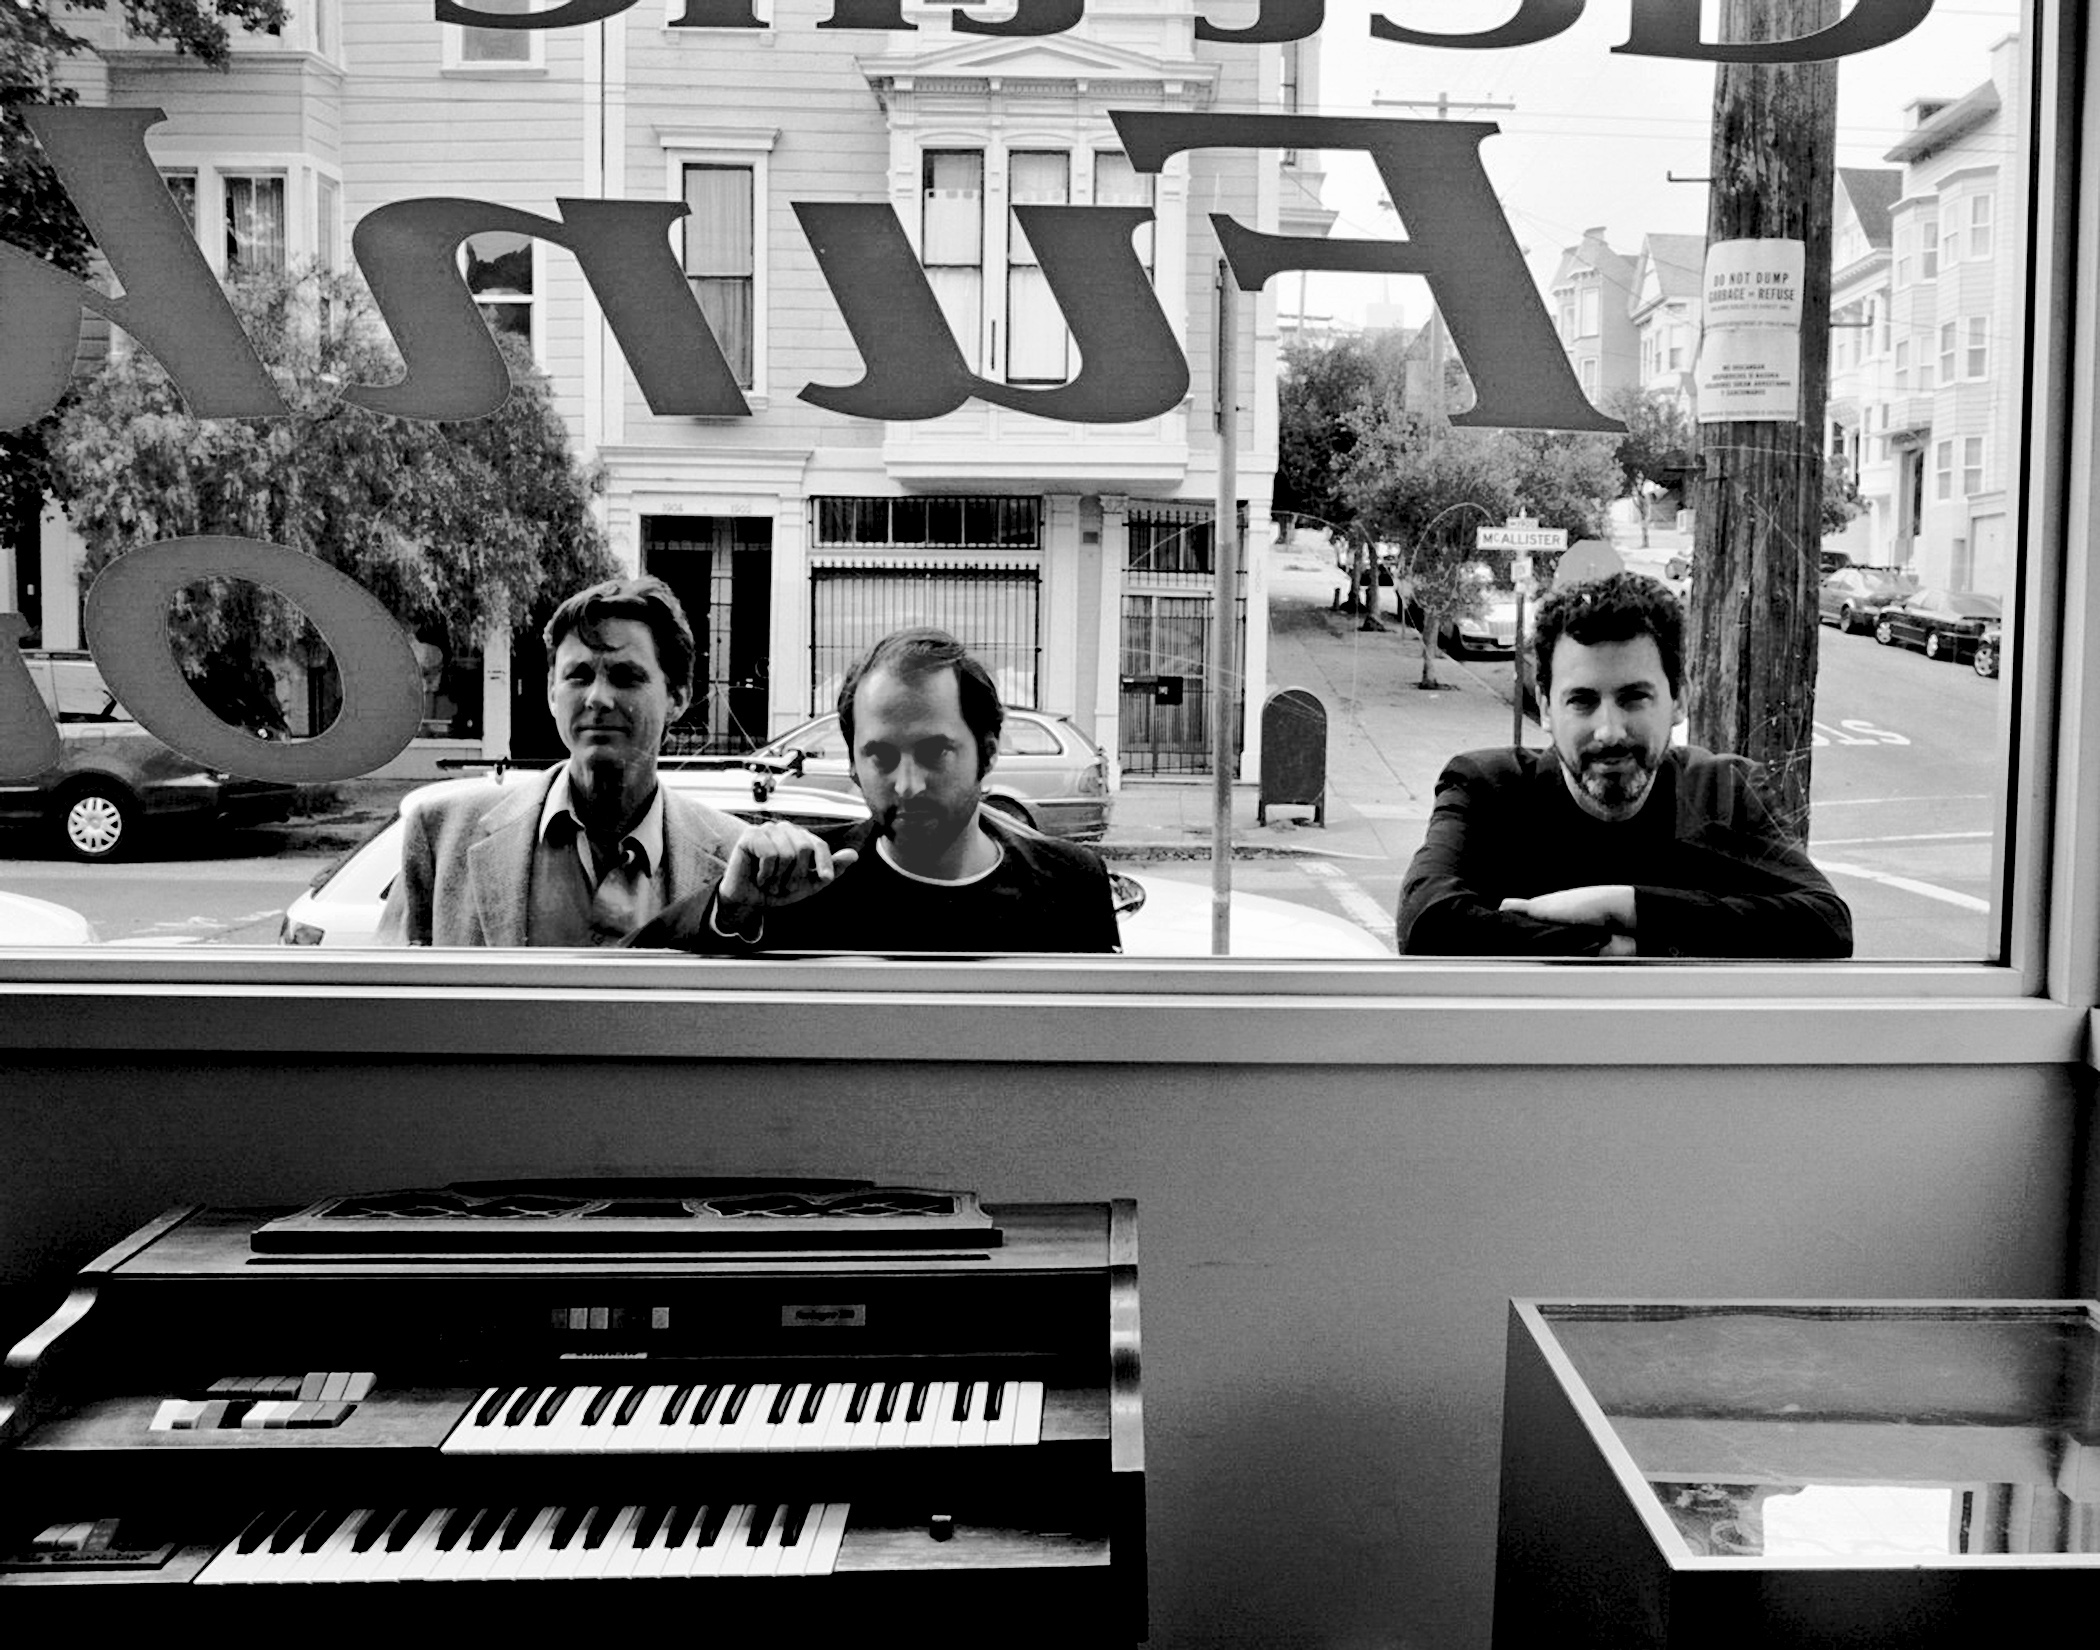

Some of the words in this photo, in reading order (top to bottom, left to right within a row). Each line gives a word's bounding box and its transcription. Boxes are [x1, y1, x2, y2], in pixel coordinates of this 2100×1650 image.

[1714, 274, 1725, 287] DO
[1729, 272, 1750, 285] NOT
[1756, 272, 1789, 284] DUMP
[1708, 288, 1745, 303] GARBAGE
[1758, 288, 1795, 300] REFUSE
